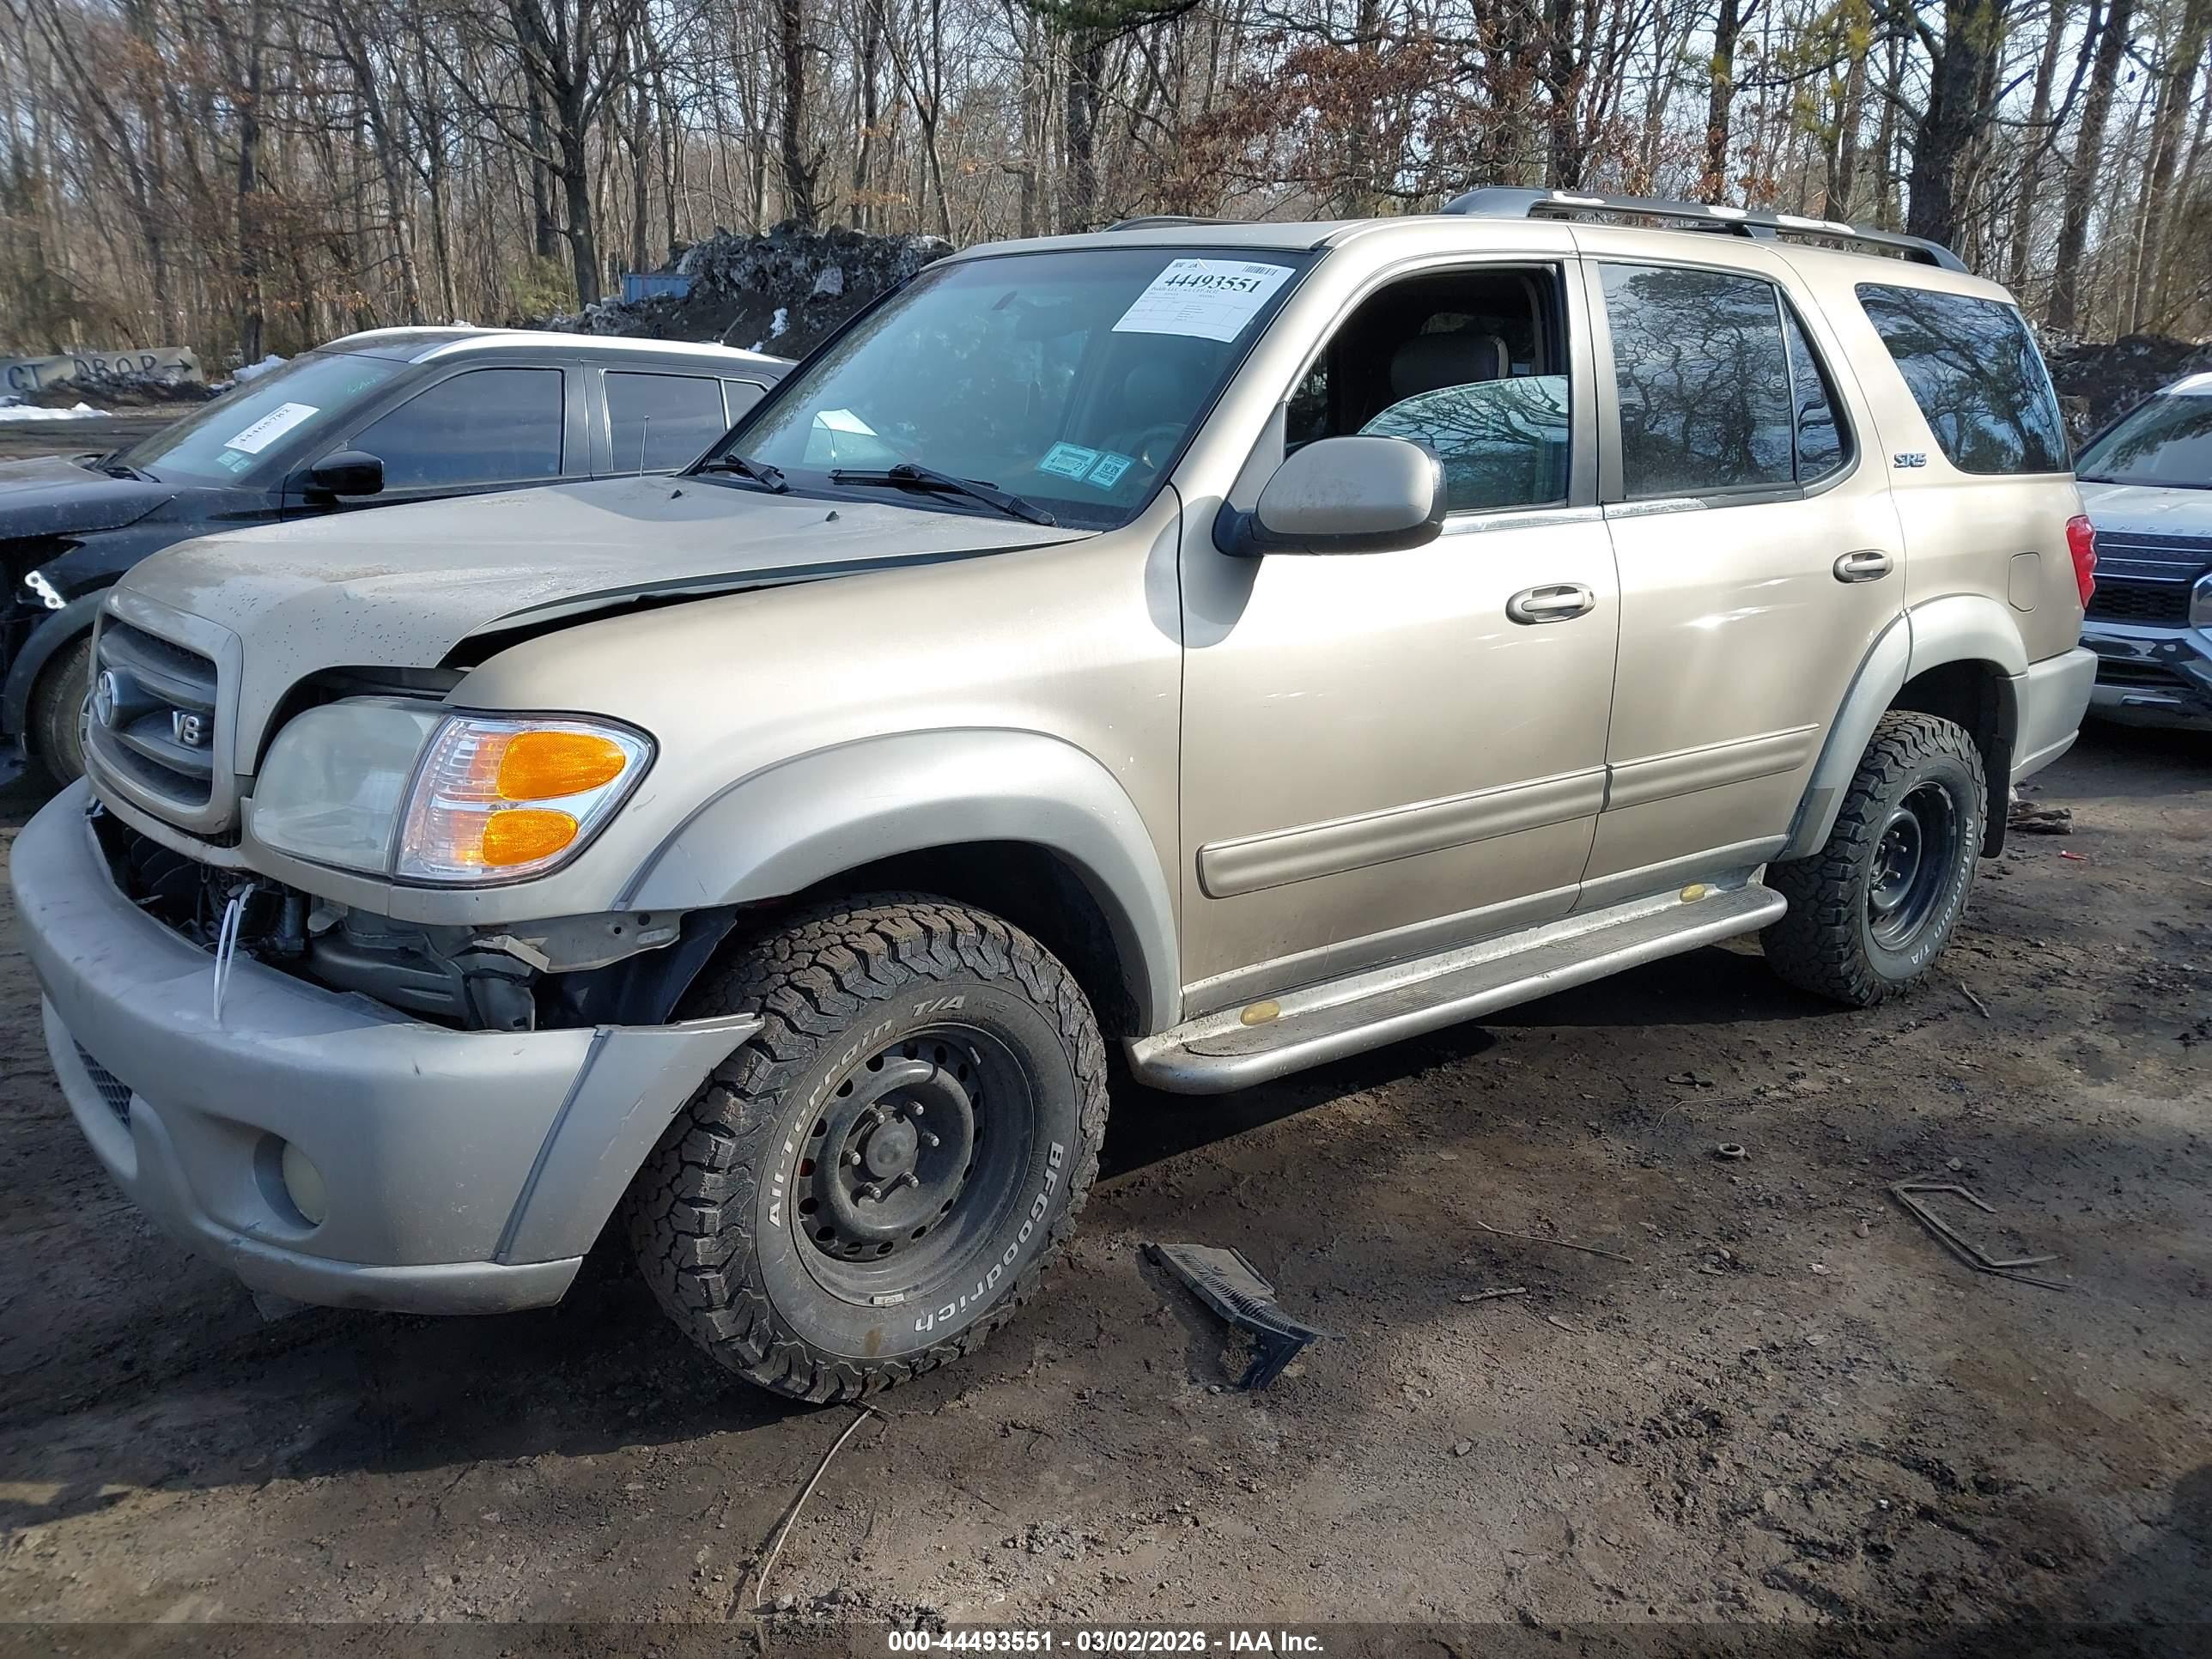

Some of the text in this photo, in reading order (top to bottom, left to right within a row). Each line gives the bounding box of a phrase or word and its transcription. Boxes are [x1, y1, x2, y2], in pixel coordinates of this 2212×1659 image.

[1164, 273, 1262, 294] 44493551
[8, 364, 45, 392] CT
[1073, 462, 1089, 471] 27
[1893, 453, 1927, 469] SR5
[173, 710, 200, 746] V8
[1910, 817, 1975, 965] All-Terrain T/A
[767, 1019, 893, 1229] All-Terrain
[911, 994, 967, 1018] T/A
[914, 1141, 1065, 1334] BFGoodrich
